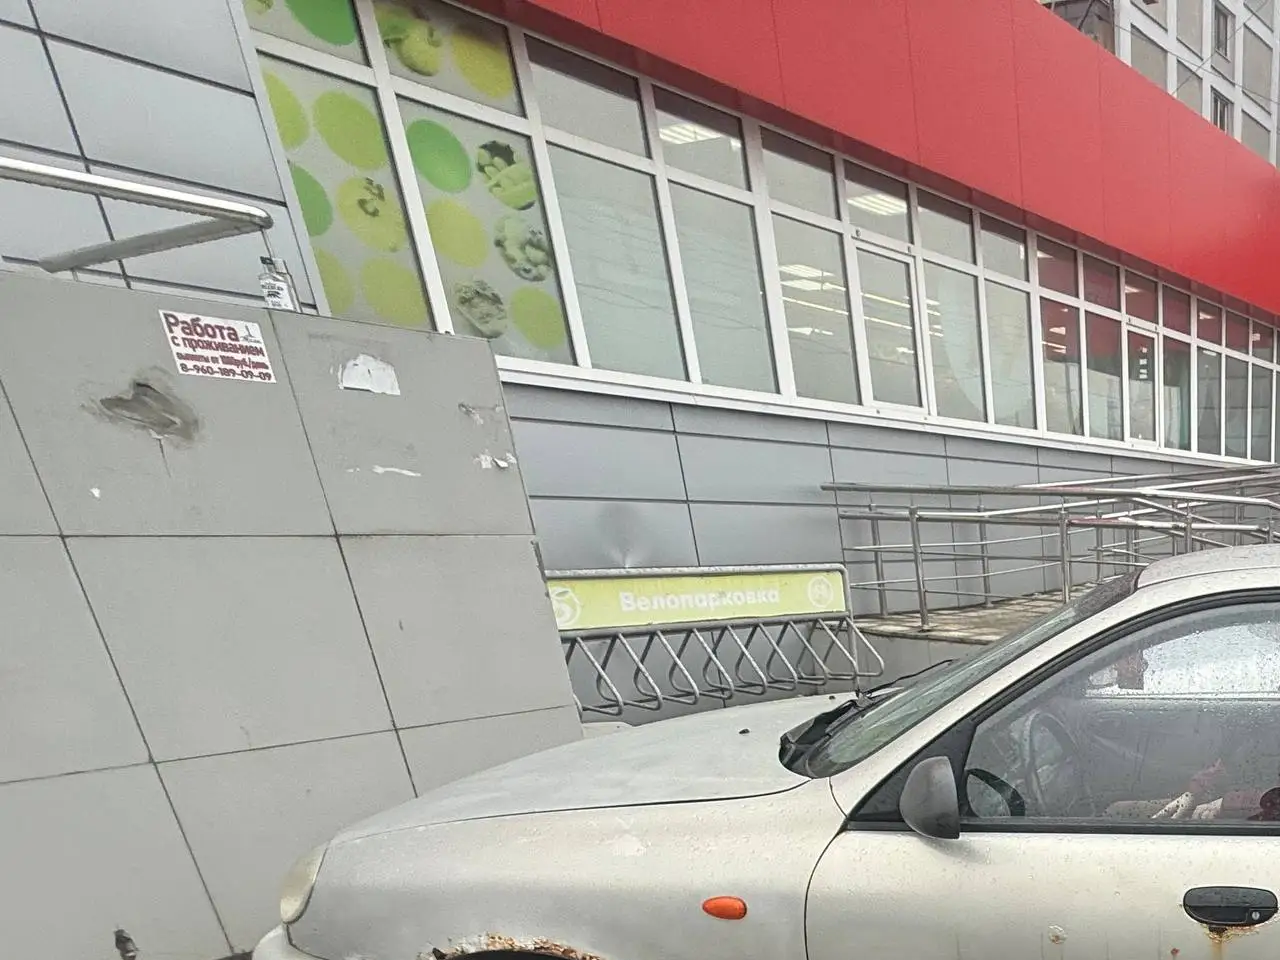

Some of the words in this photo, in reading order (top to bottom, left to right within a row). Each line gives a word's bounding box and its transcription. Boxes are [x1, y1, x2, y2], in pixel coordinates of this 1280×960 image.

[163, 312, 240, 342] Работа
[171, 335, 180, 347] с
[181, 336, 265, 357] проживанием
[180, 363, 272, 381] 8-960-189-09-09
[619, 587, 781, 613] Велопарковка
